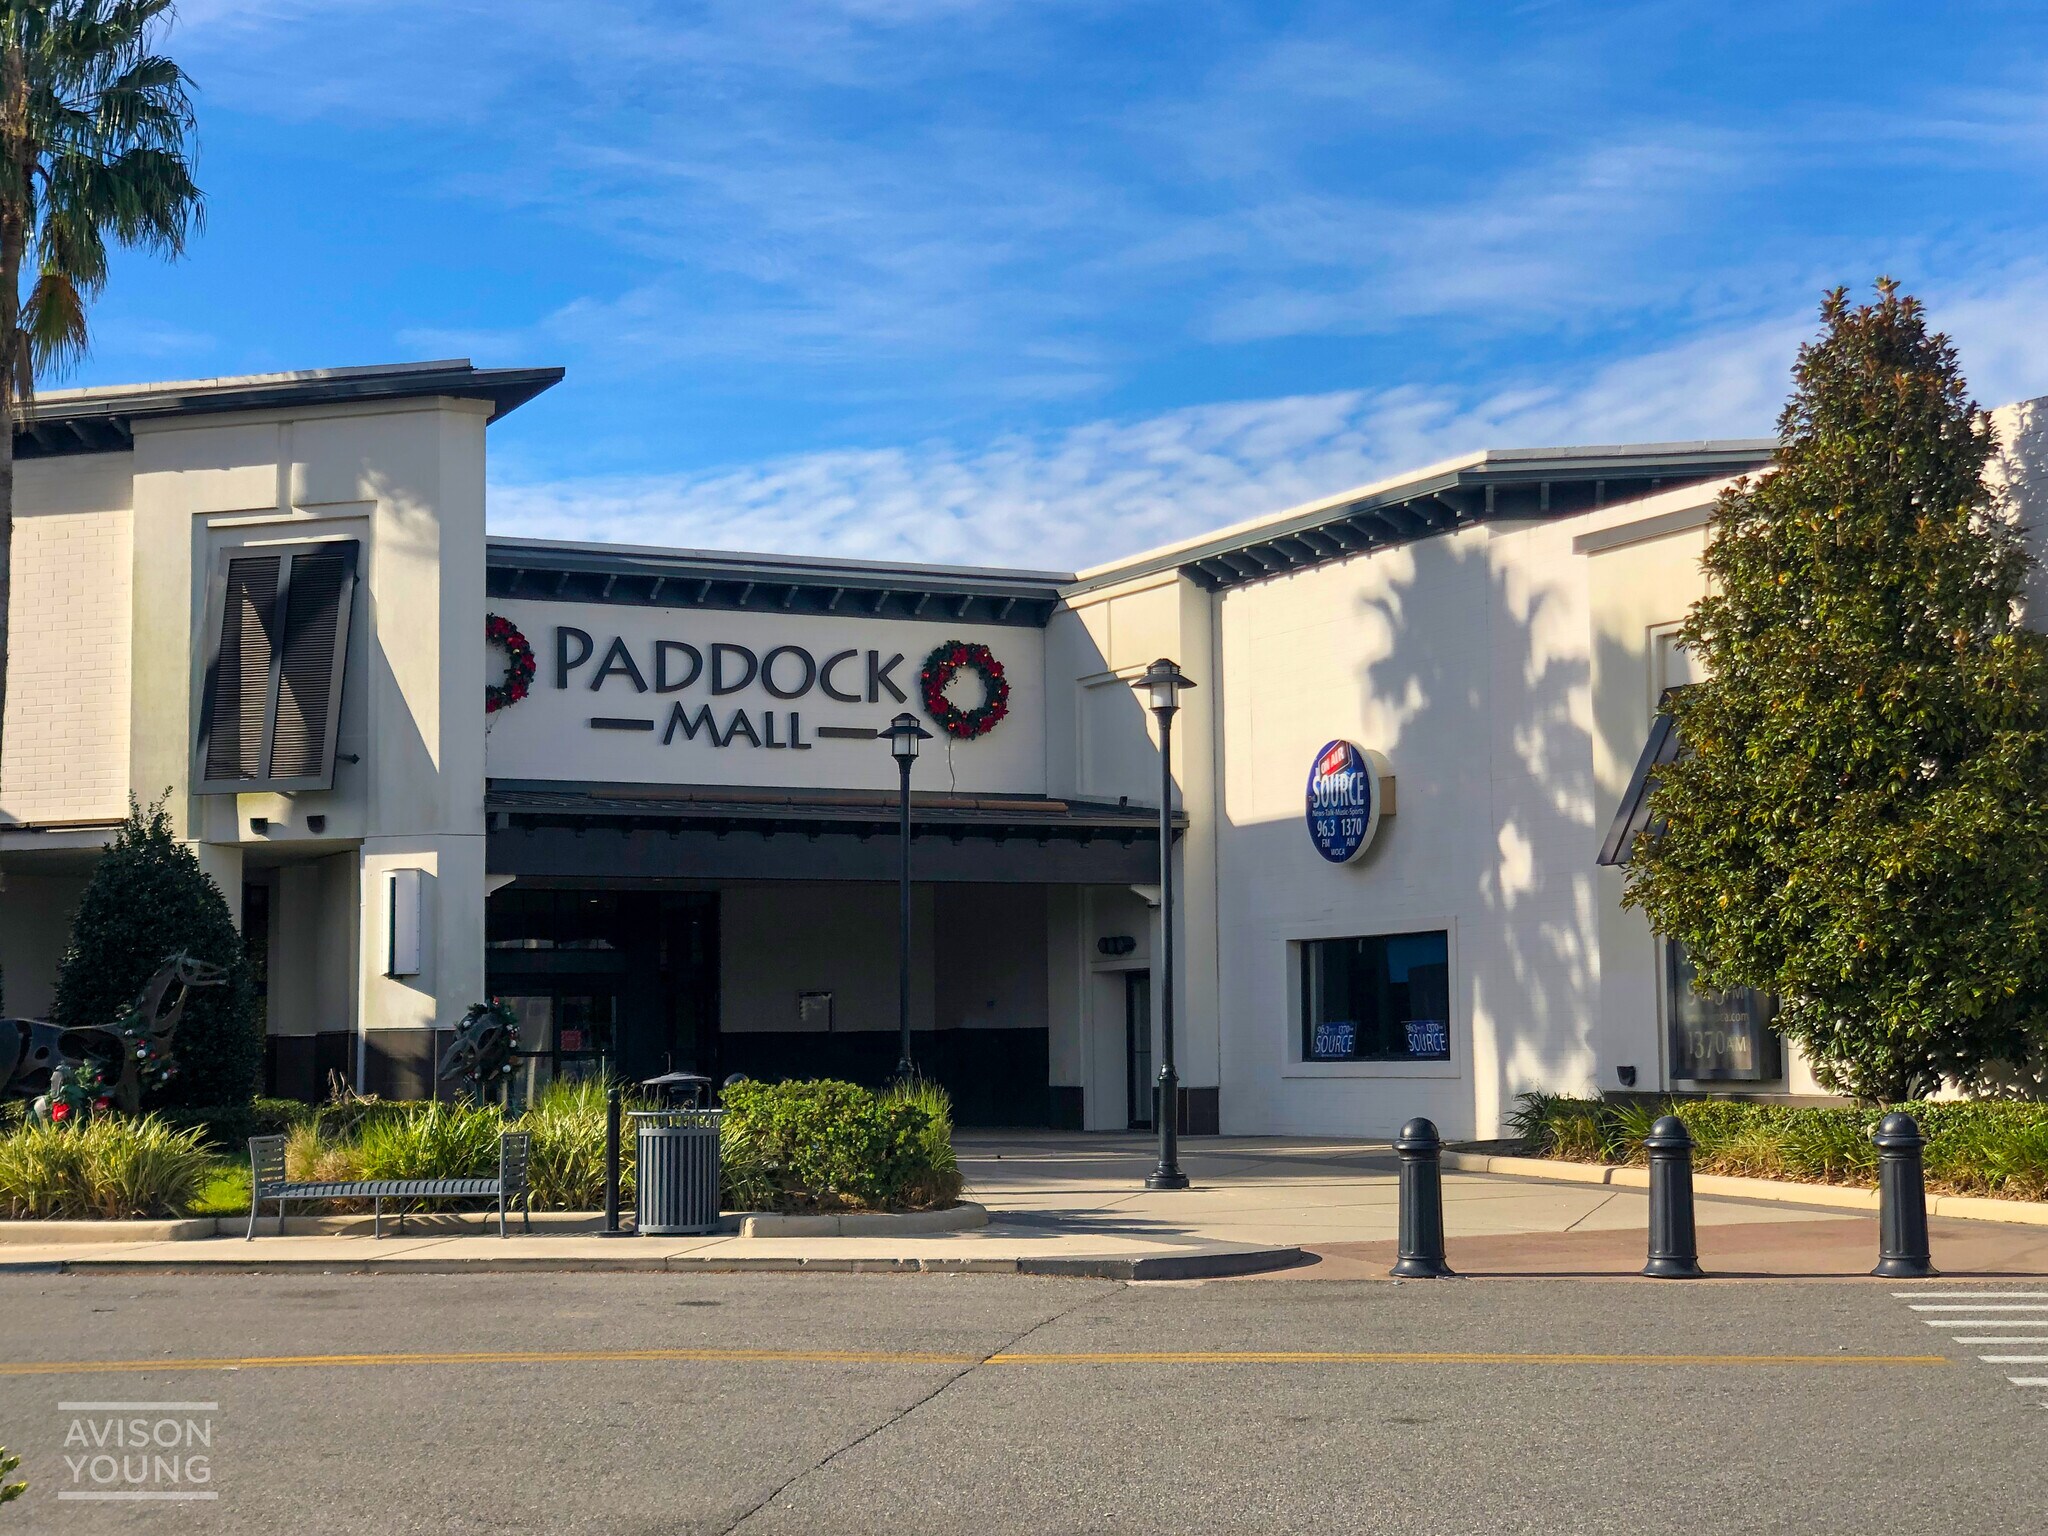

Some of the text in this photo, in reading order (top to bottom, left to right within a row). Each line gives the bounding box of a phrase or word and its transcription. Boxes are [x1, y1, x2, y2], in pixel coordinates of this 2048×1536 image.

[556, 626, 908, 704] PADDOCK
[663, 701, 812, 749] MALL
[1321, 746, 1344, 774] ON AIR
[1313, 772, 1364, 808] SOURCE
[1317, 818, 1361, 837] 96.3 1370
[1322, 838, 1355, 847] FM AM
[1315, 1035, 1353, 1053] SOURCE
[1408, 1033, 1446, 1051] SOURCE
